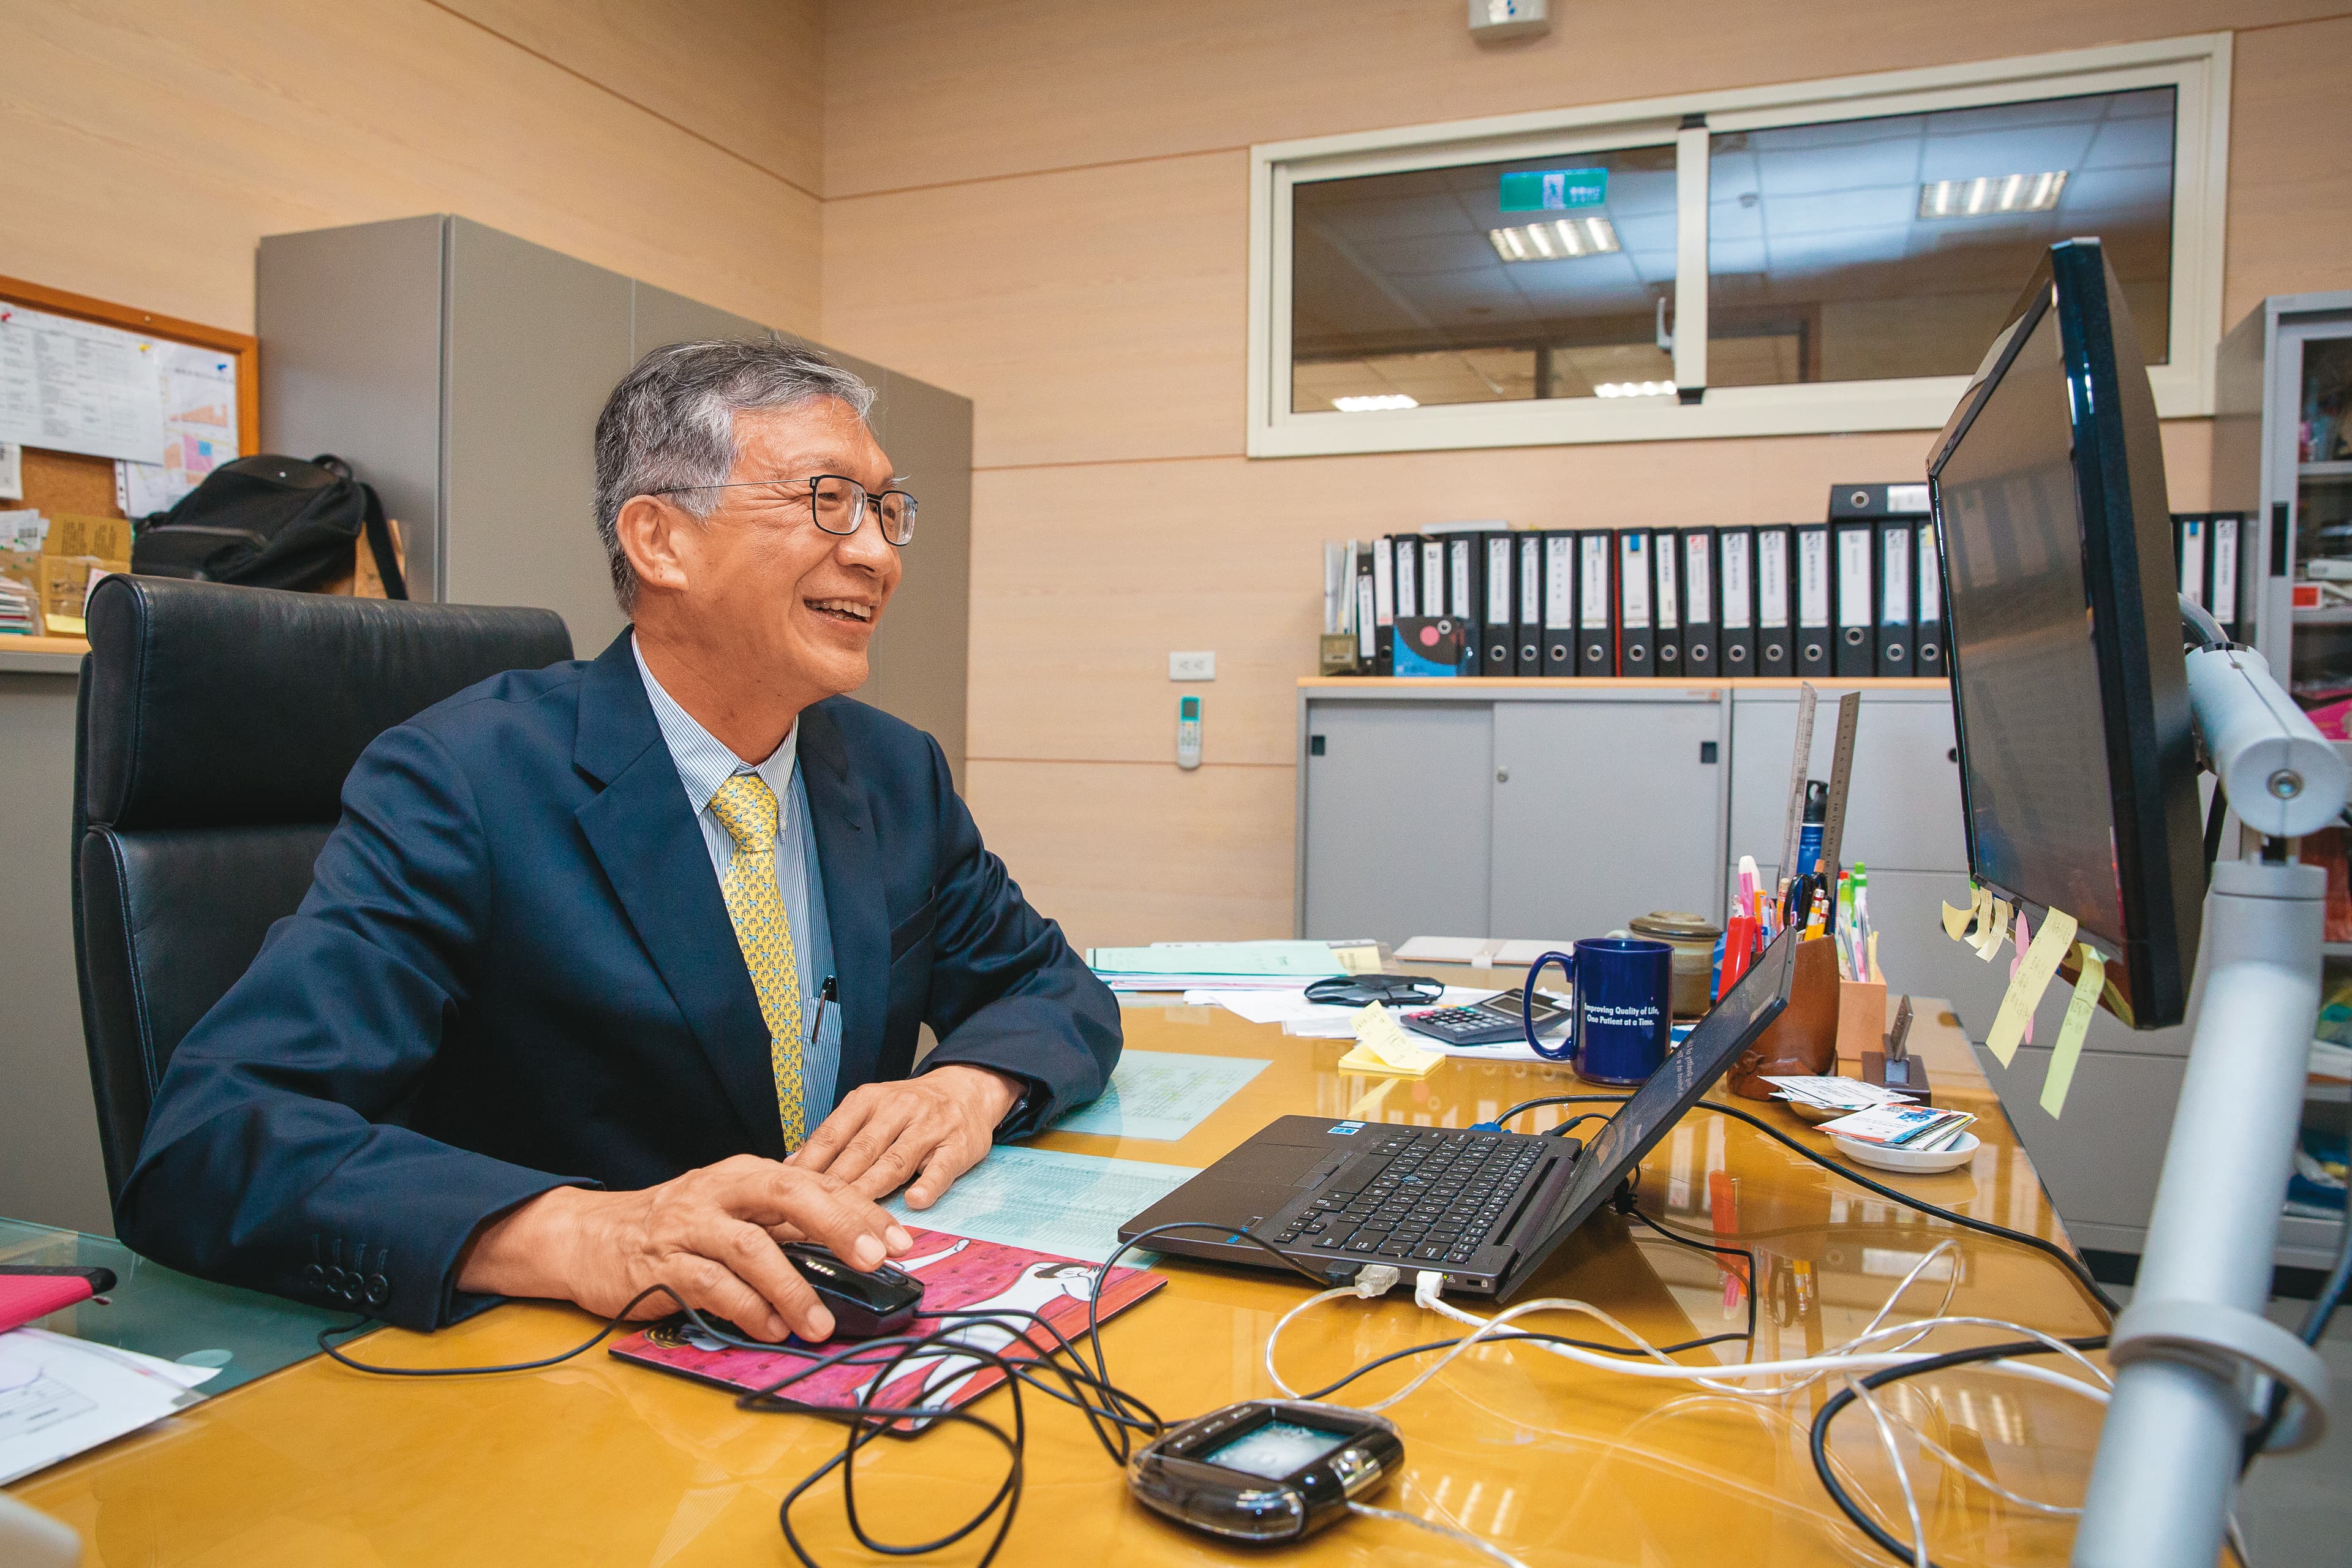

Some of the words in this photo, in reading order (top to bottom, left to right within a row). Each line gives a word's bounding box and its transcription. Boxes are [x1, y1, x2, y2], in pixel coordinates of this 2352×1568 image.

[1584, 1002, 1614, 1016] Improving
[1615, 1006, 1639, 1017] Quality
[1640, 1006, 1647, 1015] of
[1648, 1006, 1660, 1015] Life,
[1587, 1014, 1599, 1023] One
[1599, 1016, 1623, 1025] Patient
